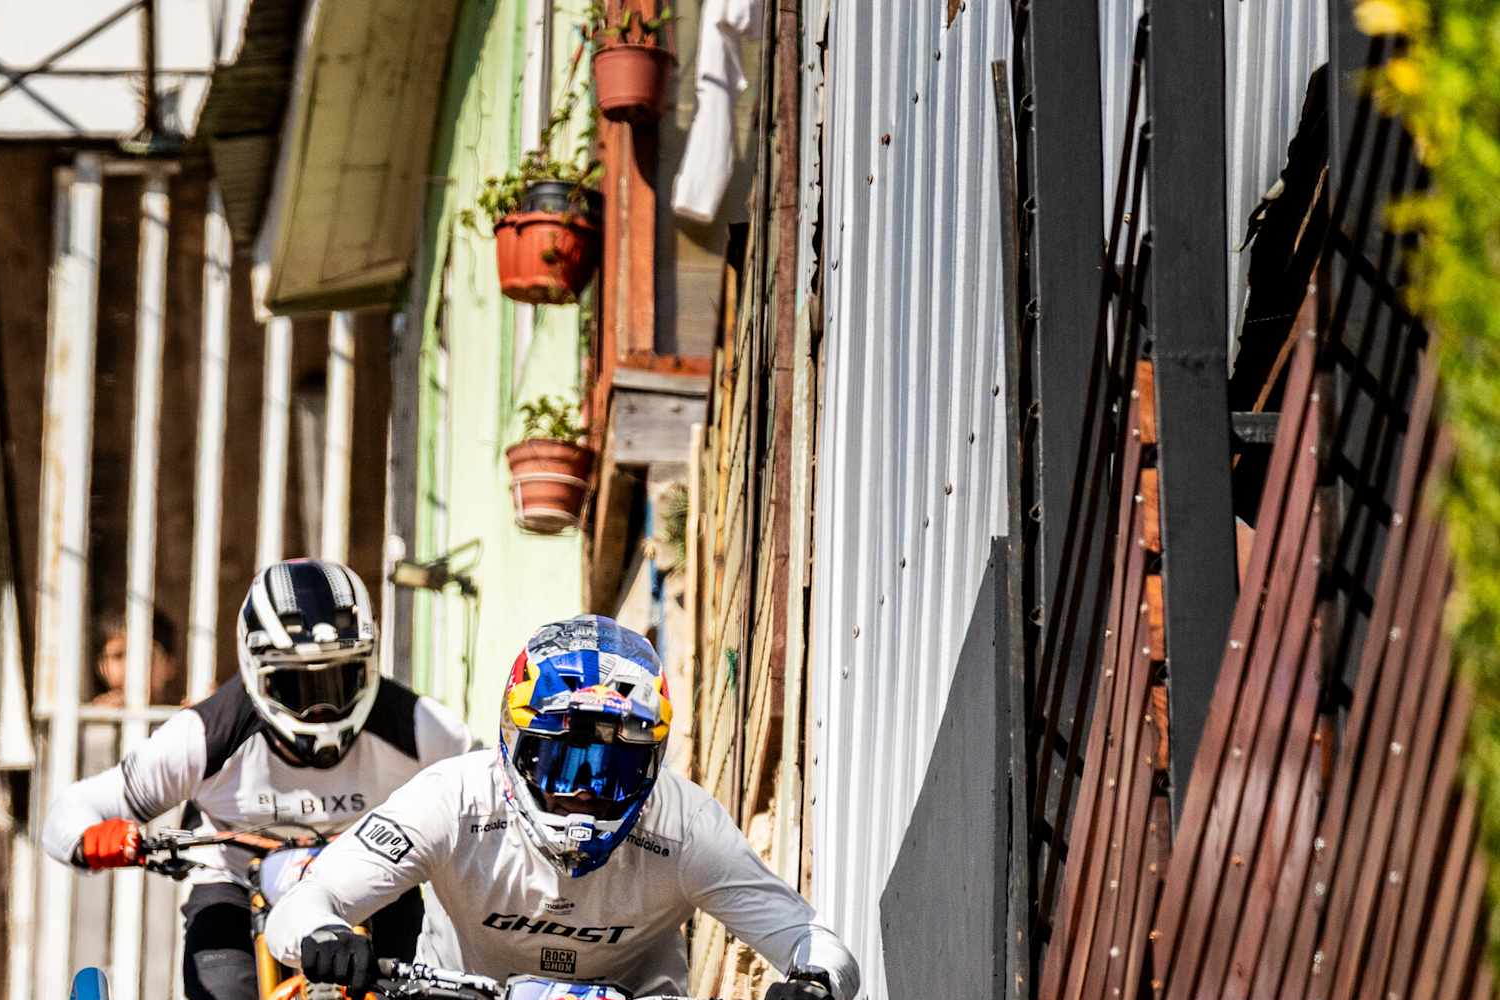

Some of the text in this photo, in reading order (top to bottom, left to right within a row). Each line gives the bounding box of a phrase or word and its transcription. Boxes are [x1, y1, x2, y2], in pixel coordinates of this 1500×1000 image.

[301, 793, 366, 815] BIXS
[365, 822, 404, 857] 100%
[482, 912, 635, 944] GHOST
[544, 950, 573, 962] ROCK
